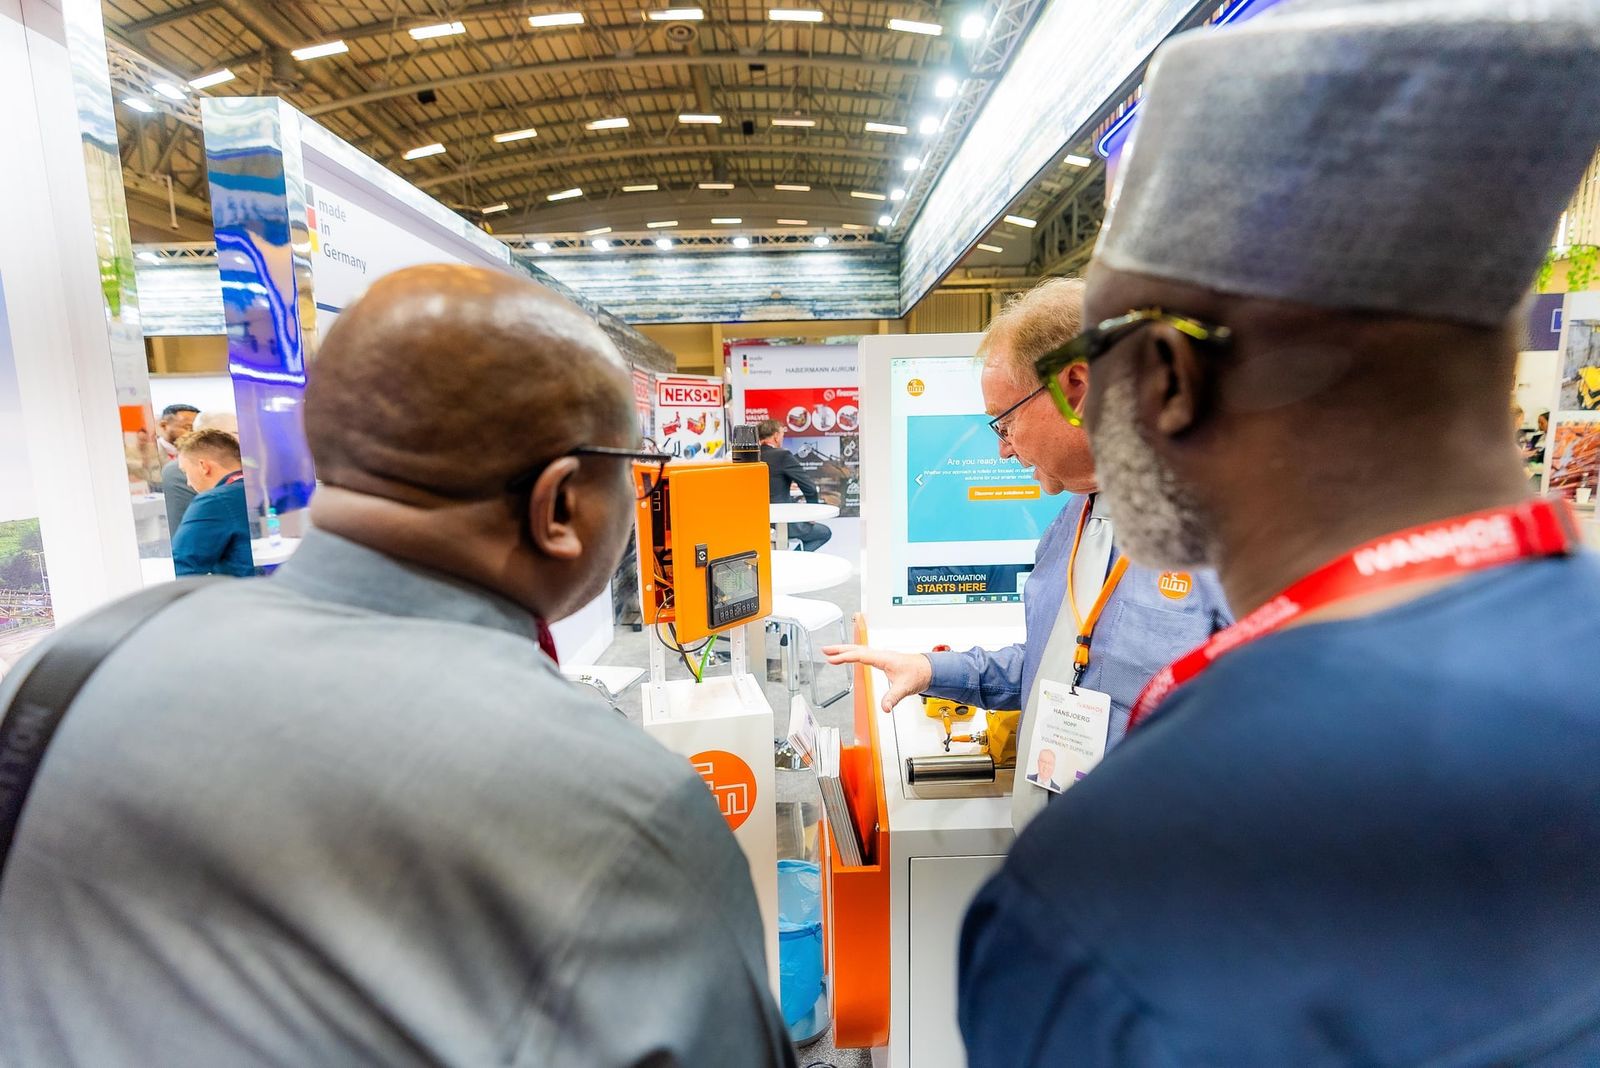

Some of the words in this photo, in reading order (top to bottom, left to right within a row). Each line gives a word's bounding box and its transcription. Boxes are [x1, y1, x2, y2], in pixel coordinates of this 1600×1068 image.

[319, 200, 346, 222] made
[320, 218, 331, 236] in
[323, 243, 367, 274] Germany
[961, 459, 975, 467] you
[977, 458, 997, 466] ready
[938, 574, 987, 582] AUTOMATION
[916, 583, 956, 593] STARTS
[958, 582, 987, 592] HERE
[1053, 708, 1091, 723] HANSJOERG
